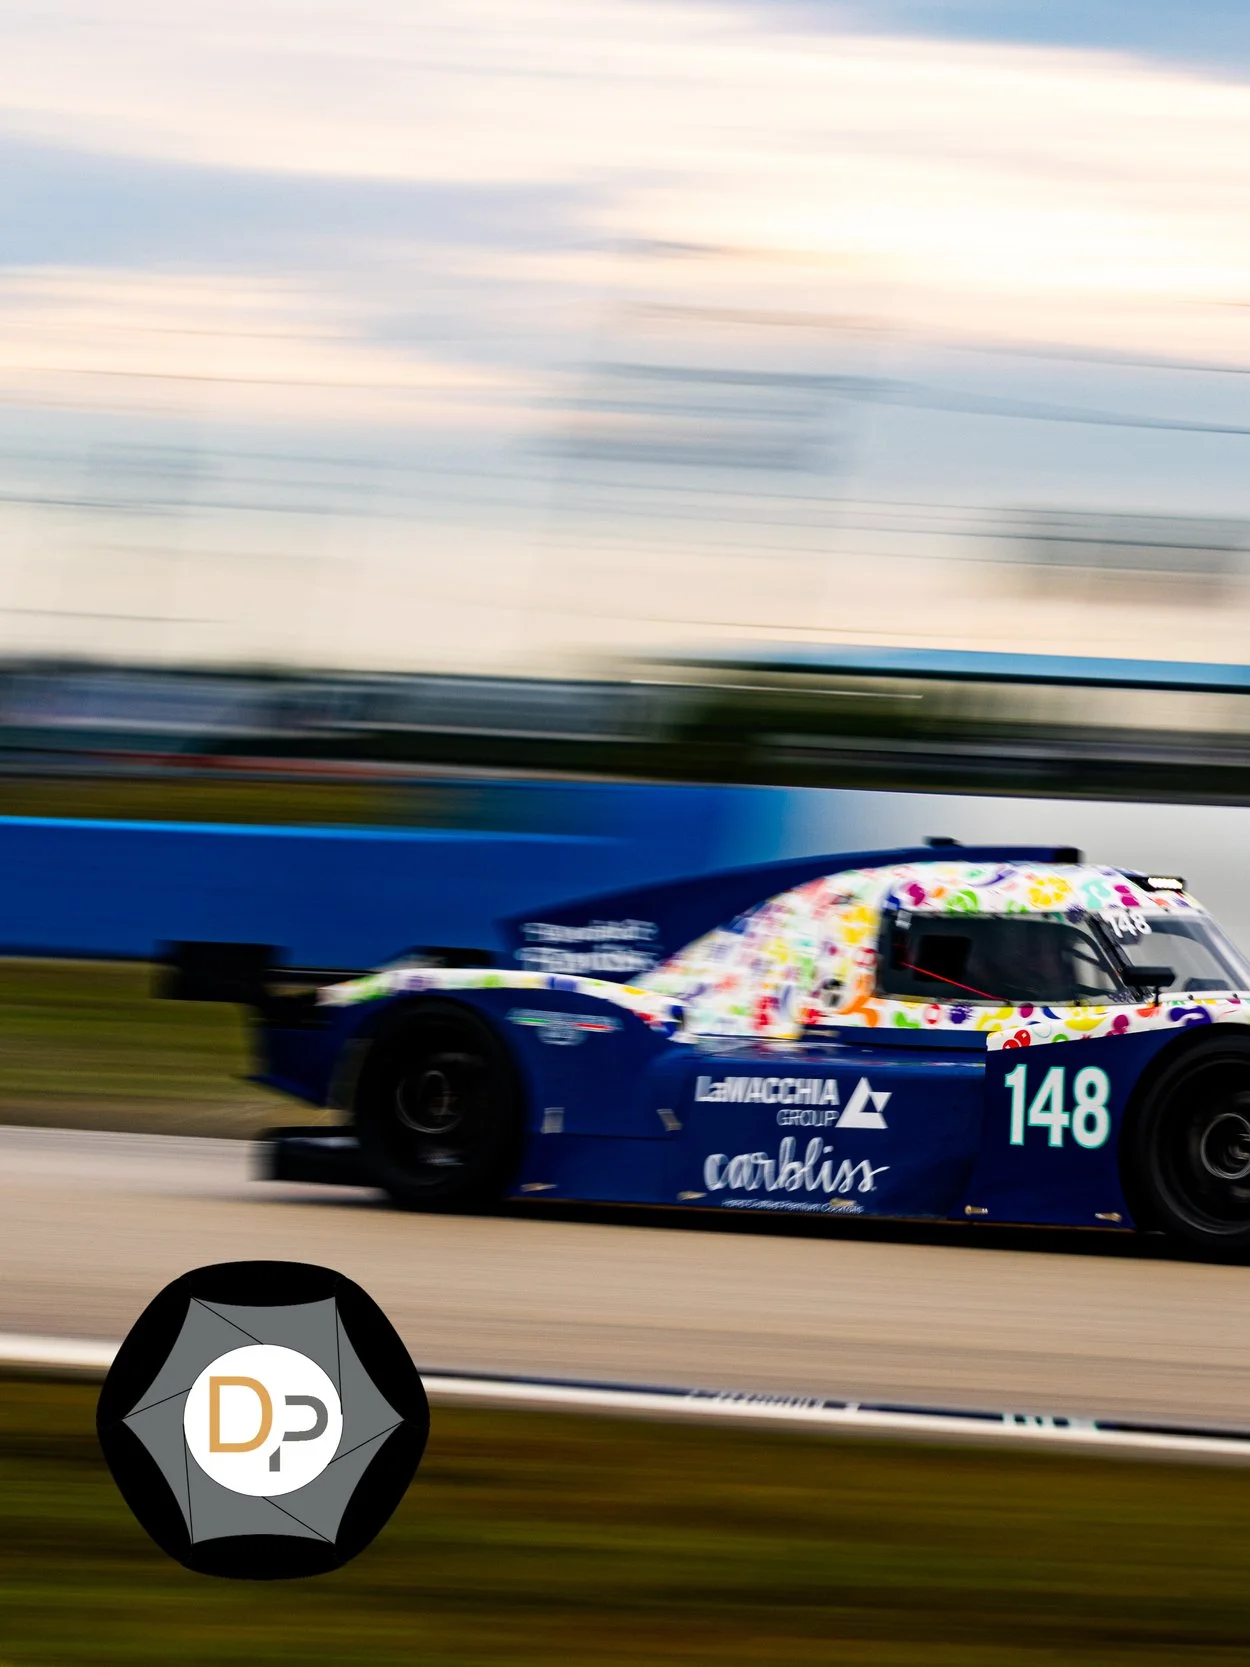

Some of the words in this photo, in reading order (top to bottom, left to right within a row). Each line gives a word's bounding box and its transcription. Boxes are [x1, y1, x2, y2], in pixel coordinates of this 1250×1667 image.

[1101, 908, 1152, 938] 148
[776, 1109, 839, 1127] GROUP
[1004, 1064, 1111, 1149] 148
[704, 1137, 890, 1193] carbliss
